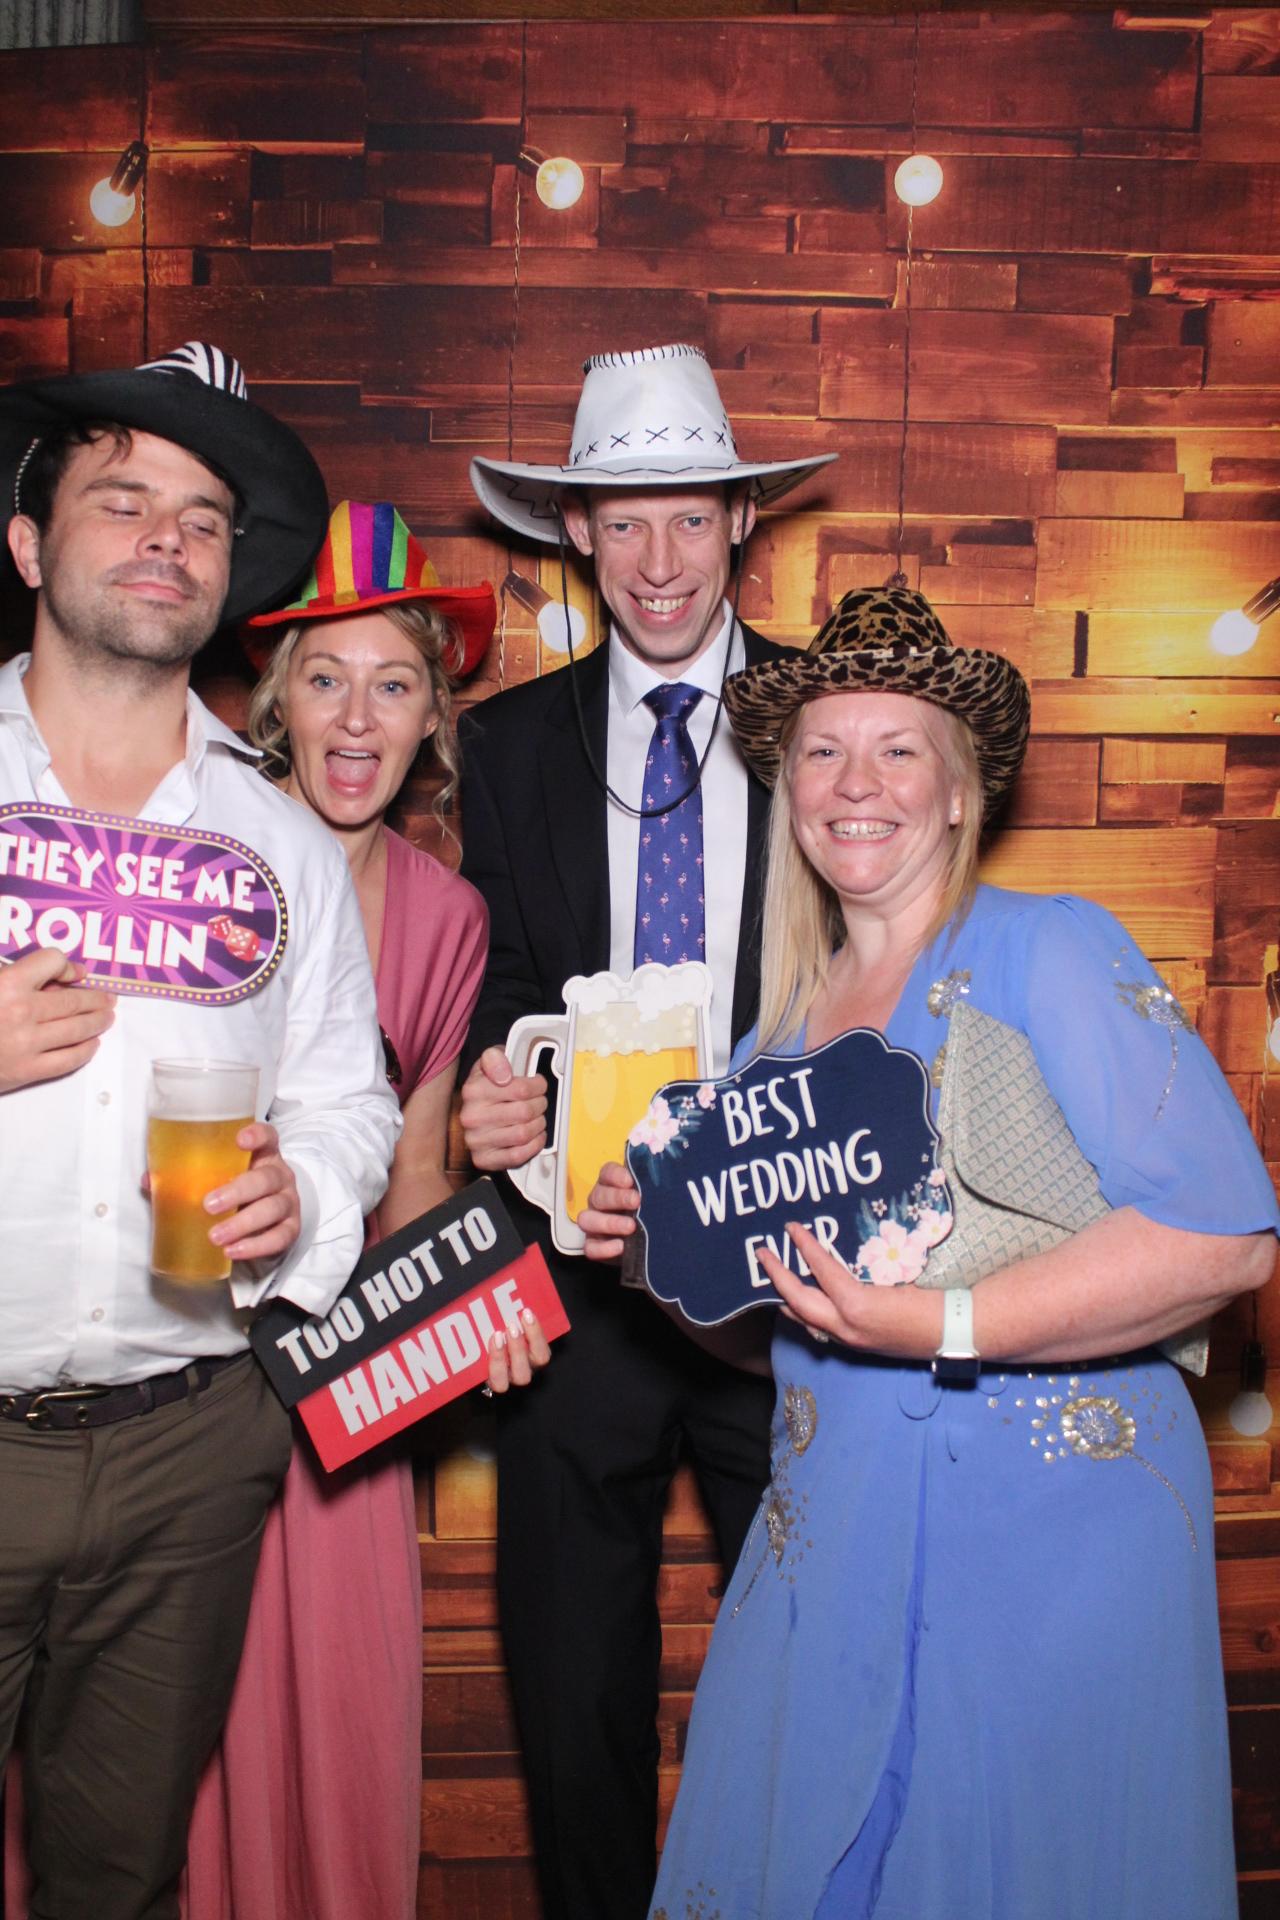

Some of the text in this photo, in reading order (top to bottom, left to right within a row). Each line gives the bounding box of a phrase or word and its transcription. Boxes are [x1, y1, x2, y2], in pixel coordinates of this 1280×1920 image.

[0, 832, 256, 913] THEY SEE ME
[0, 895, 208, 973] ROLLIN
[721, 1067, 817, 1147] BEST
[686, 1128, 883, 1227] WEDDING
[275, 1206, 498, 1375] TOO HOT TO
